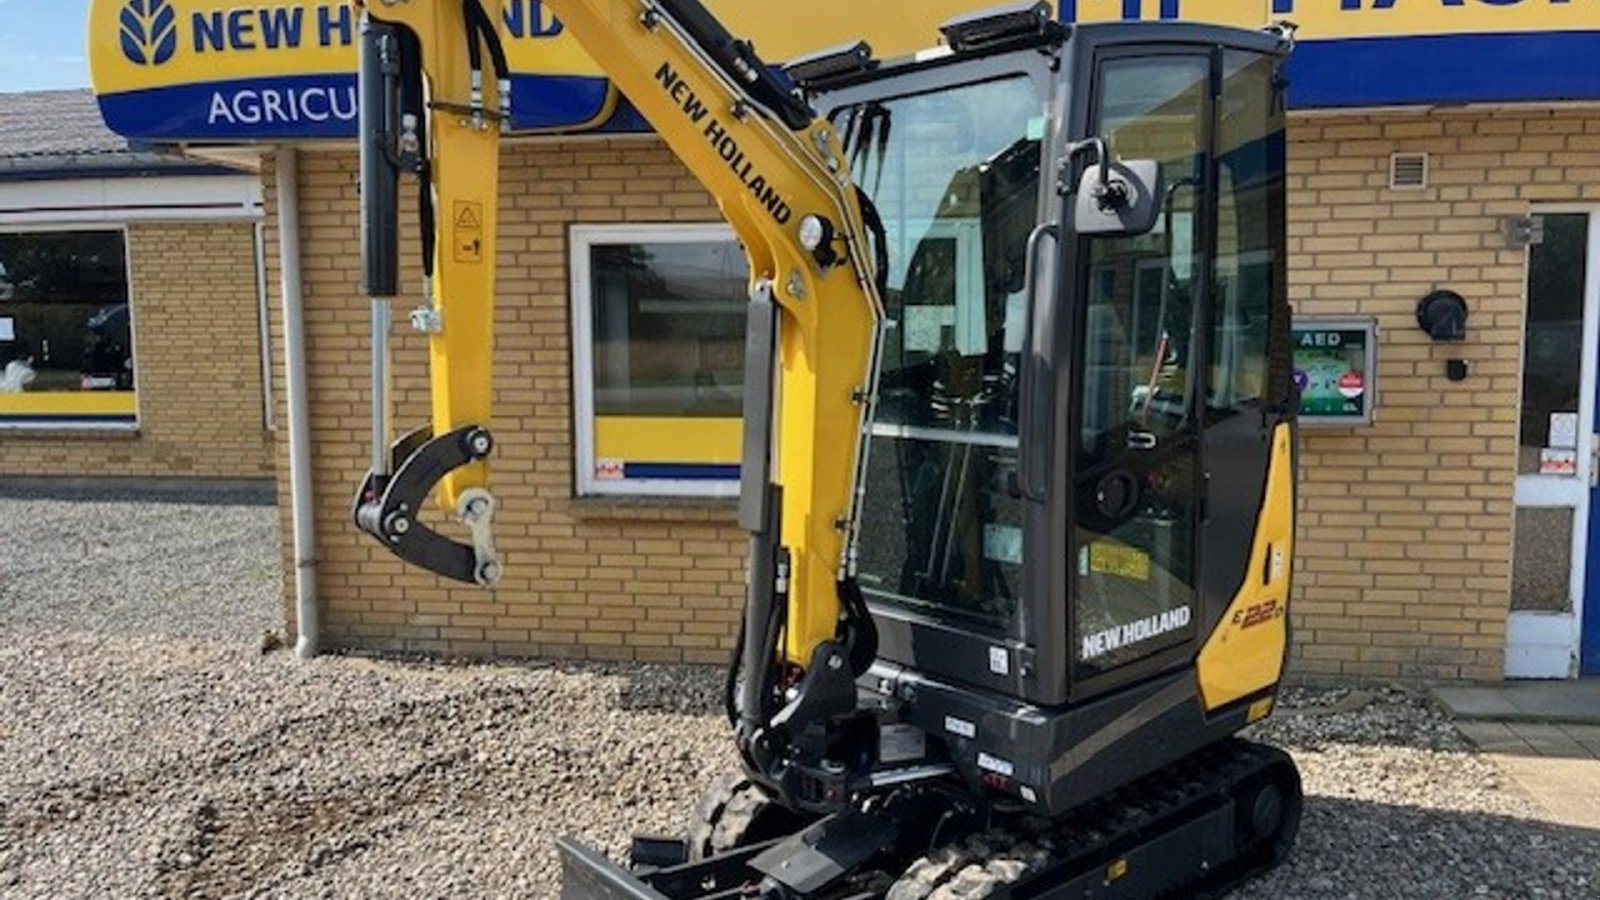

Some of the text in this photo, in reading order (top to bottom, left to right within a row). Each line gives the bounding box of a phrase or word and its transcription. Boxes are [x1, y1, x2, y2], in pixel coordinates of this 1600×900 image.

[192, 7, 304, 52] NEW
[208, 86, 358, 124] AGRICU
[655, 62, 792, 225] NEW HOLLAND
[1301, 332, 1341, 347] AED
[1082, 605, 1191, 659] NEW HOLLAND
